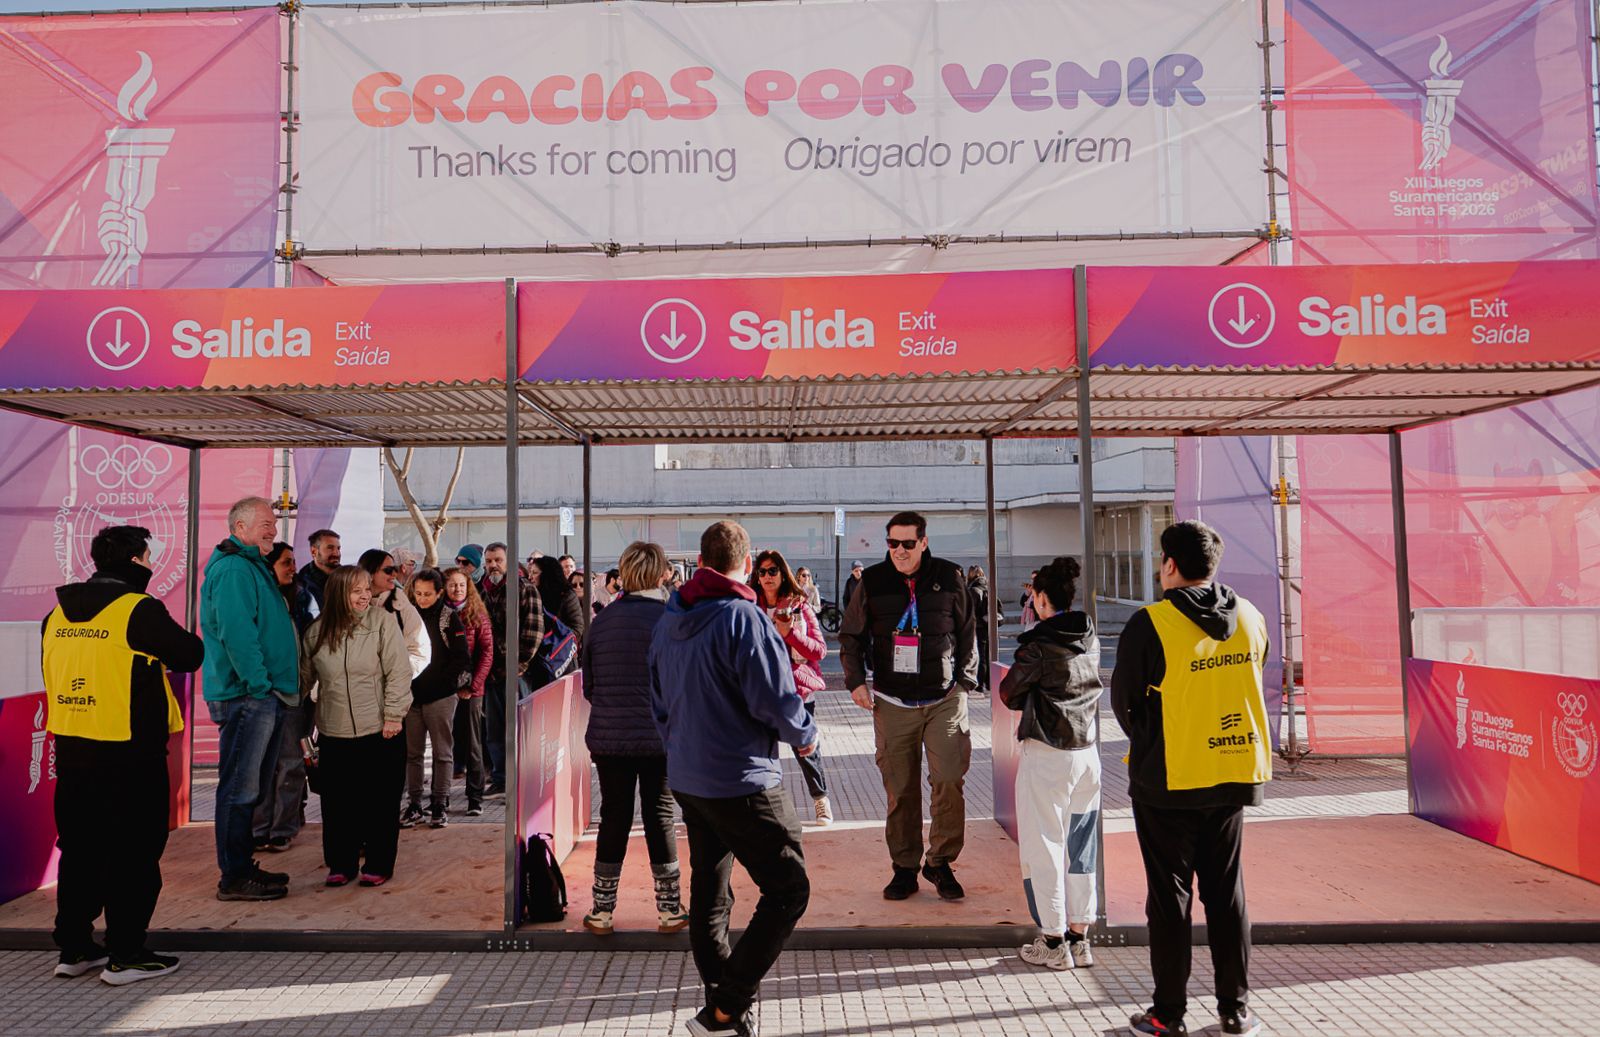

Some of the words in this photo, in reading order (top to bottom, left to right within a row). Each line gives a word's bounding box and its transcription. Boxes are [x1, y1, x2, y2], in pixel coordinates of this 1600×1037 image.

[352, 66, 718, 127] GRACIAS
[744, 64, 916, 120] POR
[941, 53, 1206, 113] VENIR
[408, 145, 537, 178] Thanks
[547, 143, 596, 175] for
[606, 140, 737, 182] coming
[784, 135, 952, 177] Obrigado
[960, 138, 1024, 174] por
[1034, 130, 1132, 163] virem
[1404, 176, 1428, 189] XIII
[1430, 176, 1484, 191] Juegos
[1389, 189, 1499, 203] Suramericanos
[1393, 204, 1435, 217] Santa
[1439, 204, 1457, 216] Fe
[1459, 203, 1496, 216] 2026
[1298, 294, 1447, 337] Salida
[1470, 298, 1509, 319] Exit
[335, 322, 372, 341] Exit
[728, 307, 875, 351] Salida
[899, 311, 937, 331] Exit
[171, 317, 312, 359] Salida
[1471, 323, 1530, 344] Saída
[334, 346, 391, 367] Saída
[899, 335, 957, 357] Saída
[96, 492, 155, 505] ODESUR
[55, 628, 110, 639] SEGURIDAD
[1190, 652, 1259, 672] SEGURIDAD
[1484, 712, 1514, 729] Juegos
[1208, 732, 1246, 749] Santa
[1472, 735, 1495, 750] Santa
[1496, 739, 1507, 753] Fe
[1508, 742, 1529, 758] 2026
